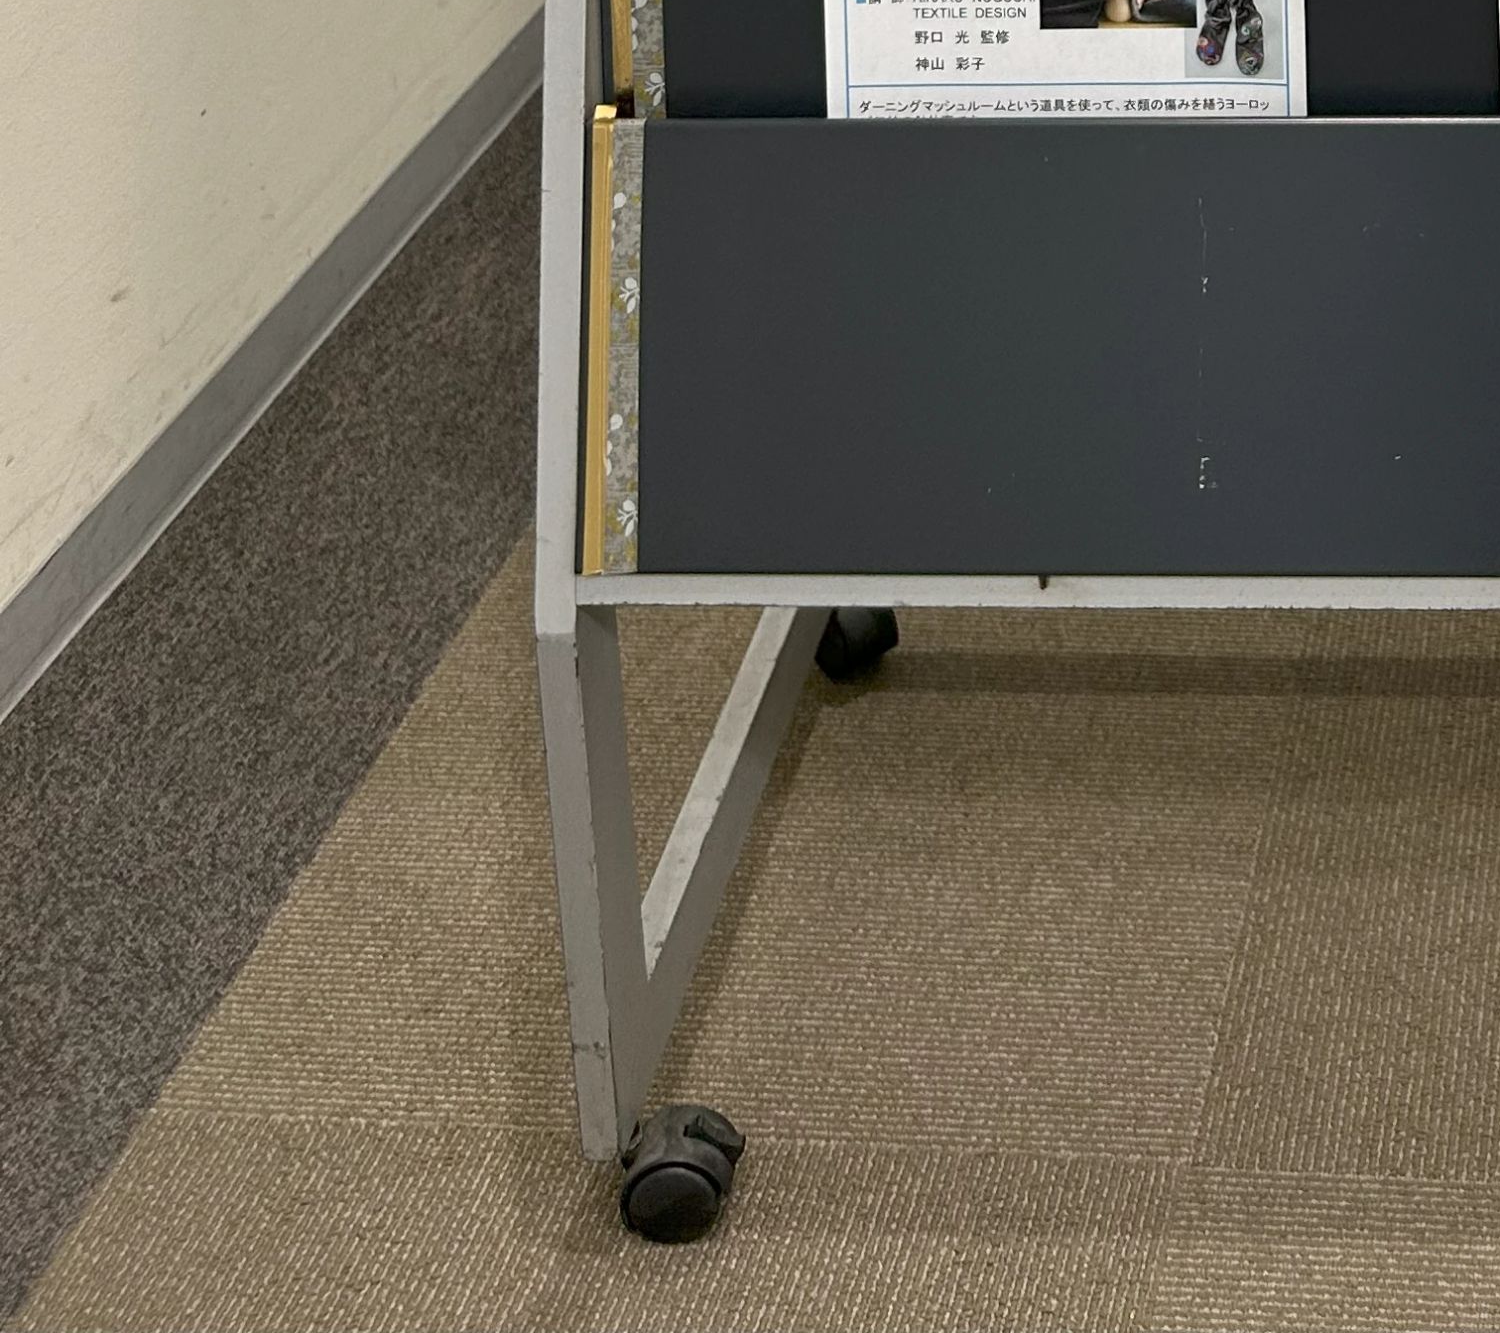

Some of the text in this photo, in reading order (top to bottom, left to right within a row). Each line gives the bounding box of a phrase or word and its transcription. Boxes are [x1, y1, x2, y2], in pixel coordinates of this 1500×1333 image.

[913, 6, 1028, 19] TEXTILE DESIGN
[914, 29, 1010, 44] 野口 光 監修
[915, 55, 985, 71] 神山 彩子
